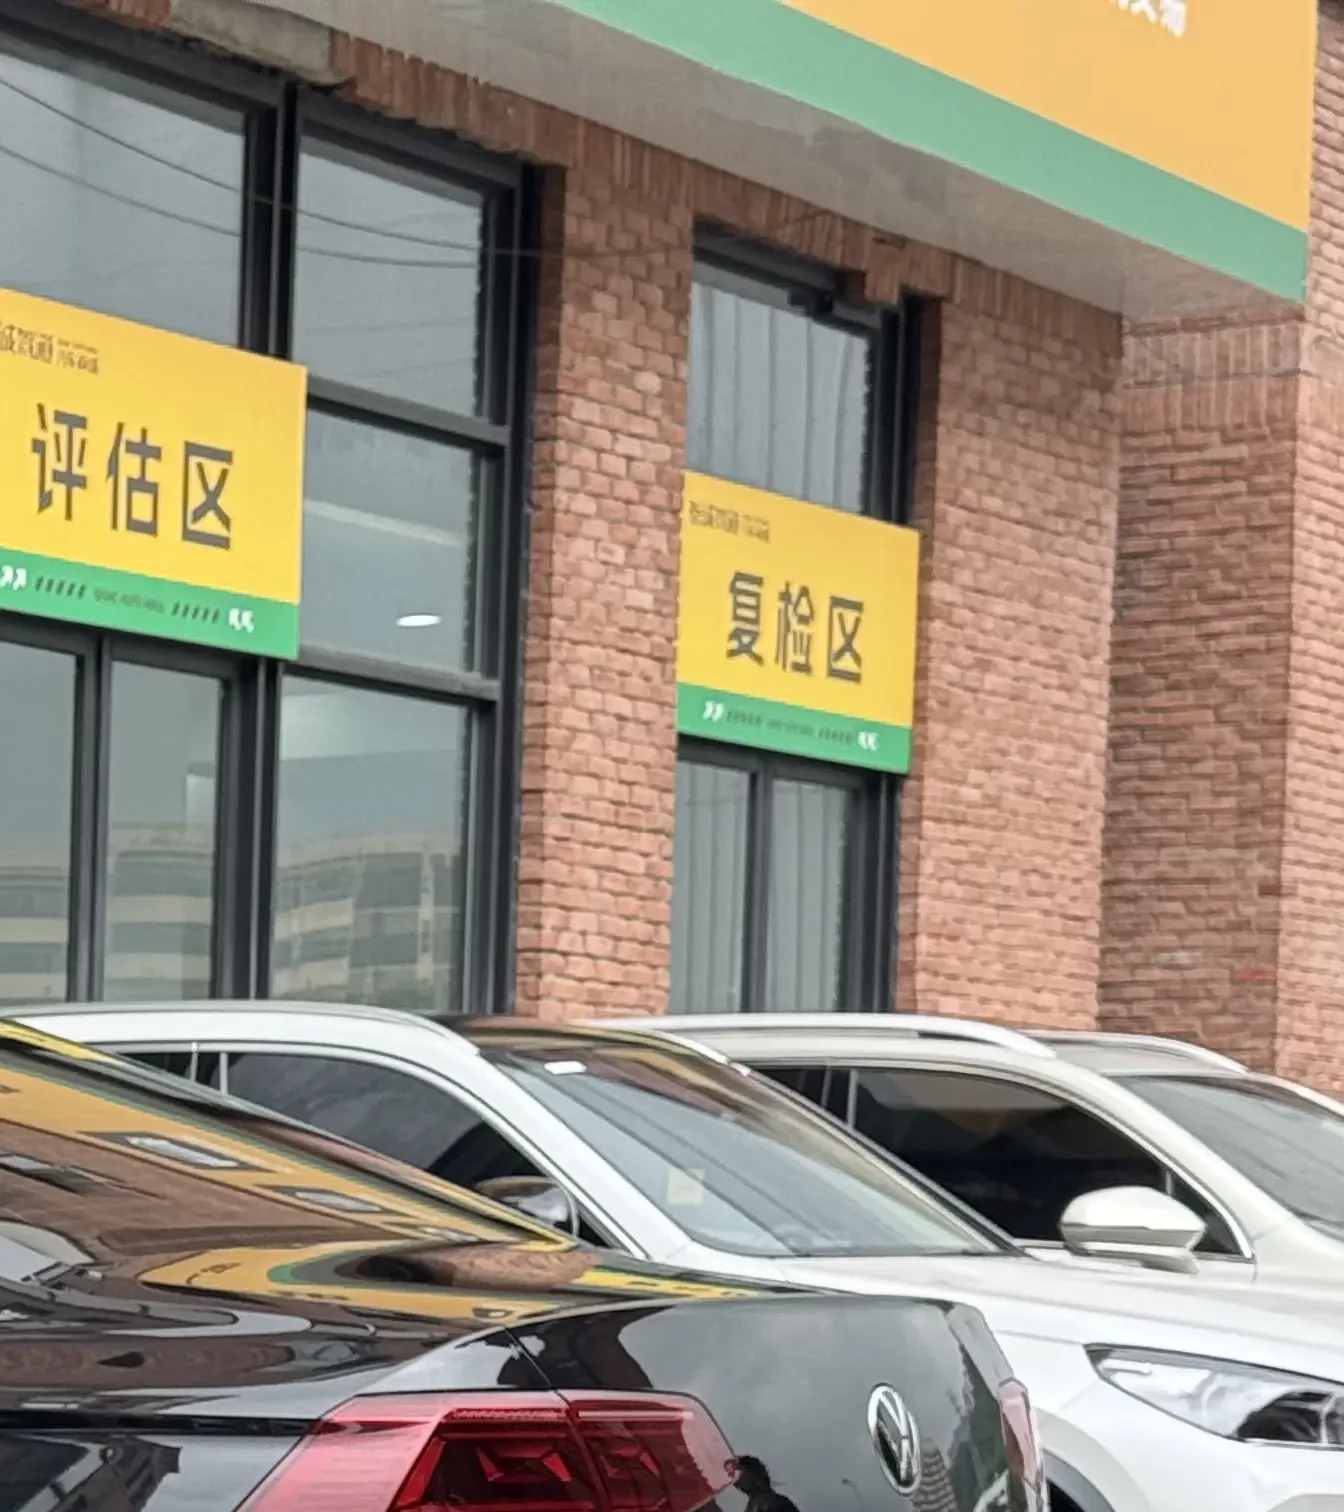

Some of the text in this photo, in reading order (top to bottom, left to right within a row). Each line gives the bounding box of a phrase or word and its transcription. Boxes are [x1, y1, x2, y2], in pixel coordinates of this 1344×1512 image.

[29, 402, 234, 551] 评估区
[725, 570, 865, 684] 复检区
